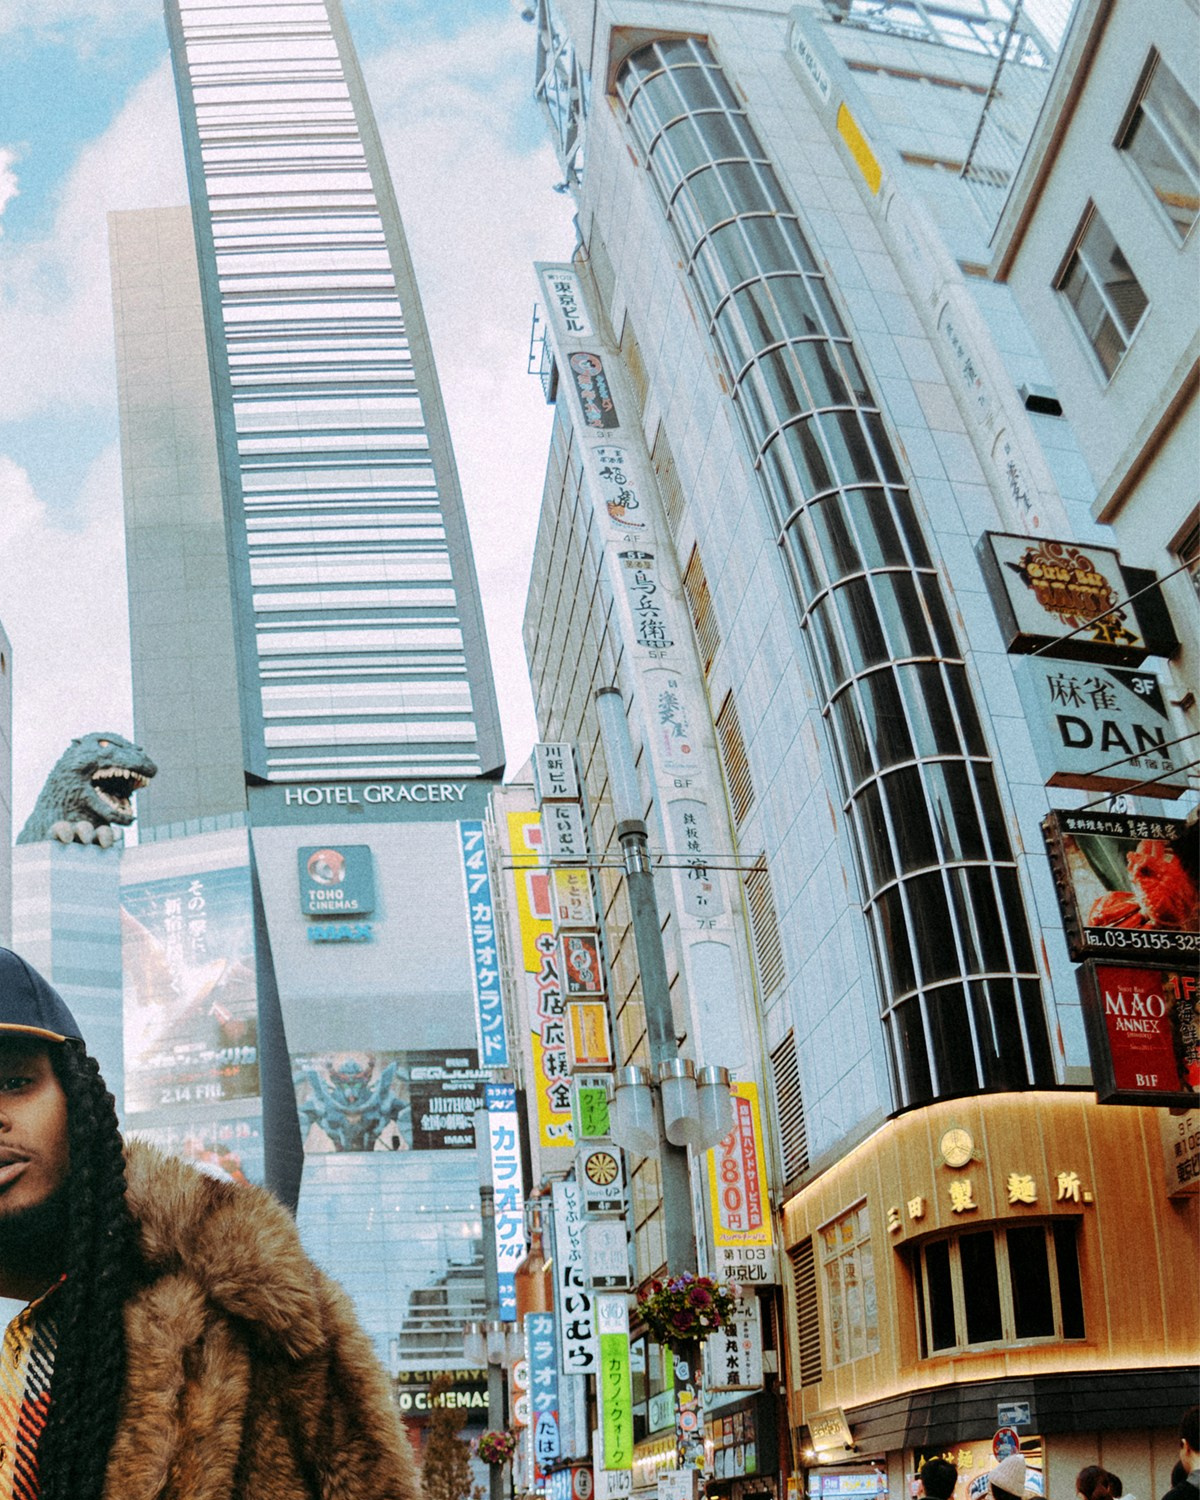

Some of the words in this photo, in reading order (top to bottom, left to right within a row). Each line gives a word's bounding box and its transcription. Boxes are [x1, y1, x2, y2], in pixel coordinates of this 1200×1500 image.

[553, 281, 584, 332] 東京ビル
[1046, 672, 1123, 712] 麻雀
[1131, 677, 1155, 696] 3F
[1055, 714, 1171, 760] DAN
[285, 786, 361, 806] HOTEL
[363, 784, 467, 803] GRACERY
[308, 889, 344, 901] TOHO
[309, 900, 359, 910] CINEMAS
[472, 902, 503, 1057] カラオケランド
[1170, 976, 1197, 1000] 1F
[1104, 991, 1167, 1018] MAO
[1116, 1018, 1160, 1033] ANNEX
[1135, 1073, 1158, 1087] B1F
[492, 1125, 524, 1241] カラオケ
[886, 1171, 1082, 1234] 三田製麺所
[564, 1187, 582, 1262] しゃぶしゃぶ
[724, 1248, 766, 1261] 第103
[723, 1265, 768, 1282] 東京ビル
[563, 1265, 595, 1367] にいむら
[531, 1315, 557, 1413] カラオケ
